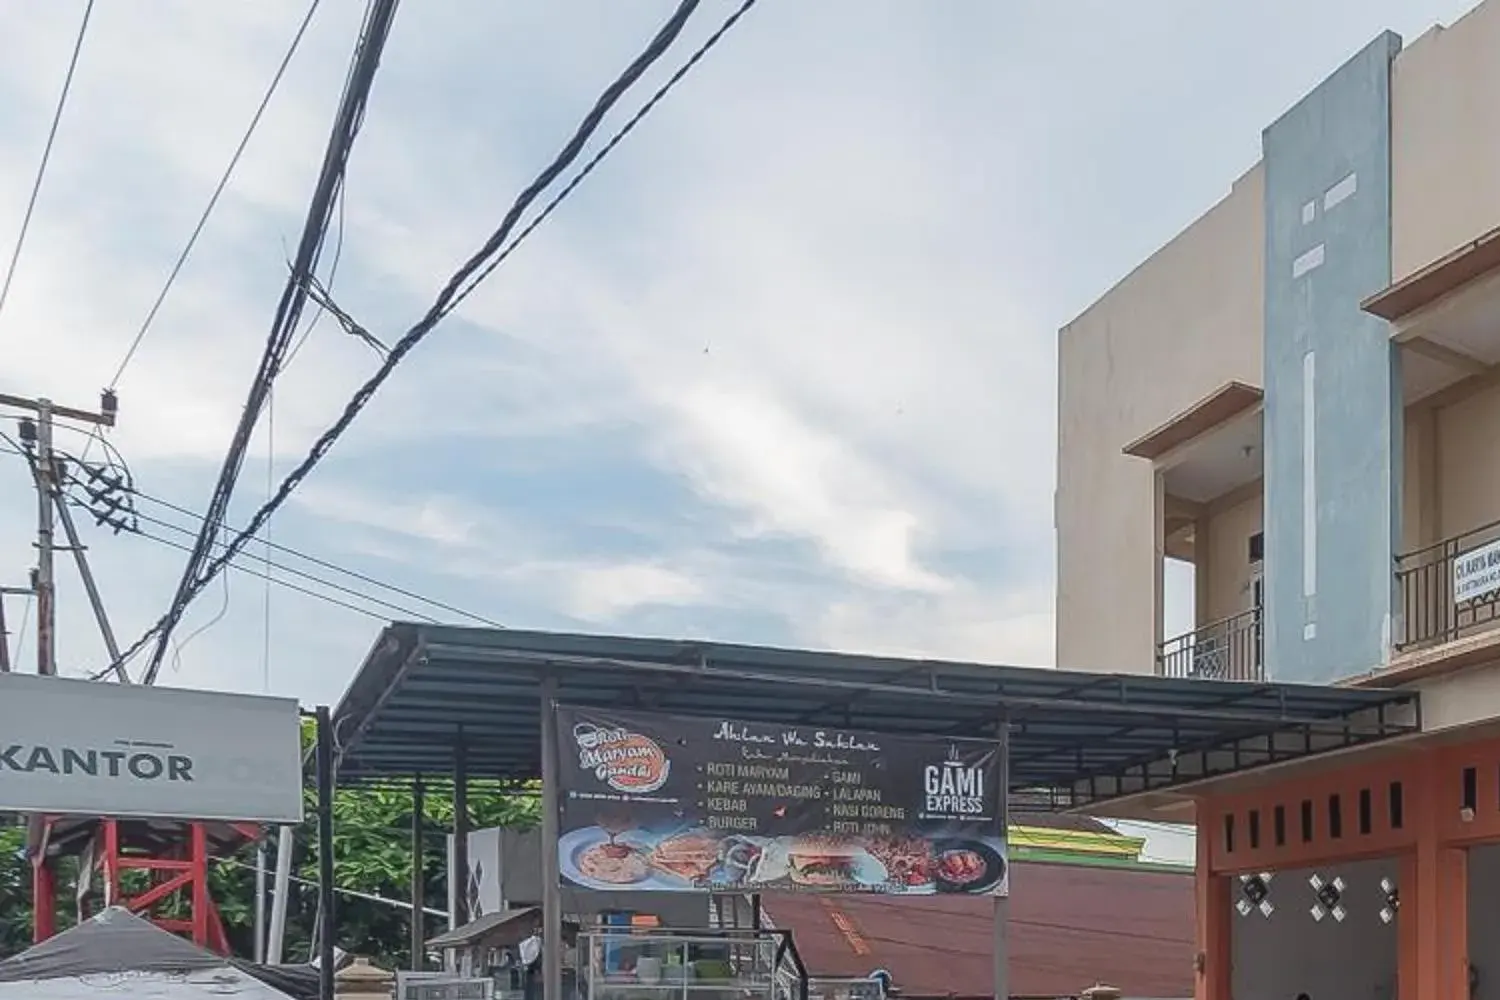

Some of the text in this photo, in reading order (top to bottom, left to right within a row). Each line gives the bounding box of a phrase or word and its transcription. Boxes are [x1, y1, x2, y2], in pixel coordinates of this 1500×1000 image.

[0, 745, 194, 782] KANTOR
[707, 762, 789, 780] ROTI MARYAM
[832, 771, 861, 784] GAMI
[925, 765, 984, 797] GAMI
[833, 788, 881, 802] LALAPAN
[707, 798, 747, 812] KEBAB
[833, 803, 859, 818] NASI
[861, 805, 905, 820] GORENG
[926, 795, 984, 813] EXPRESS
[708, 815, 757, 830] BURGER
